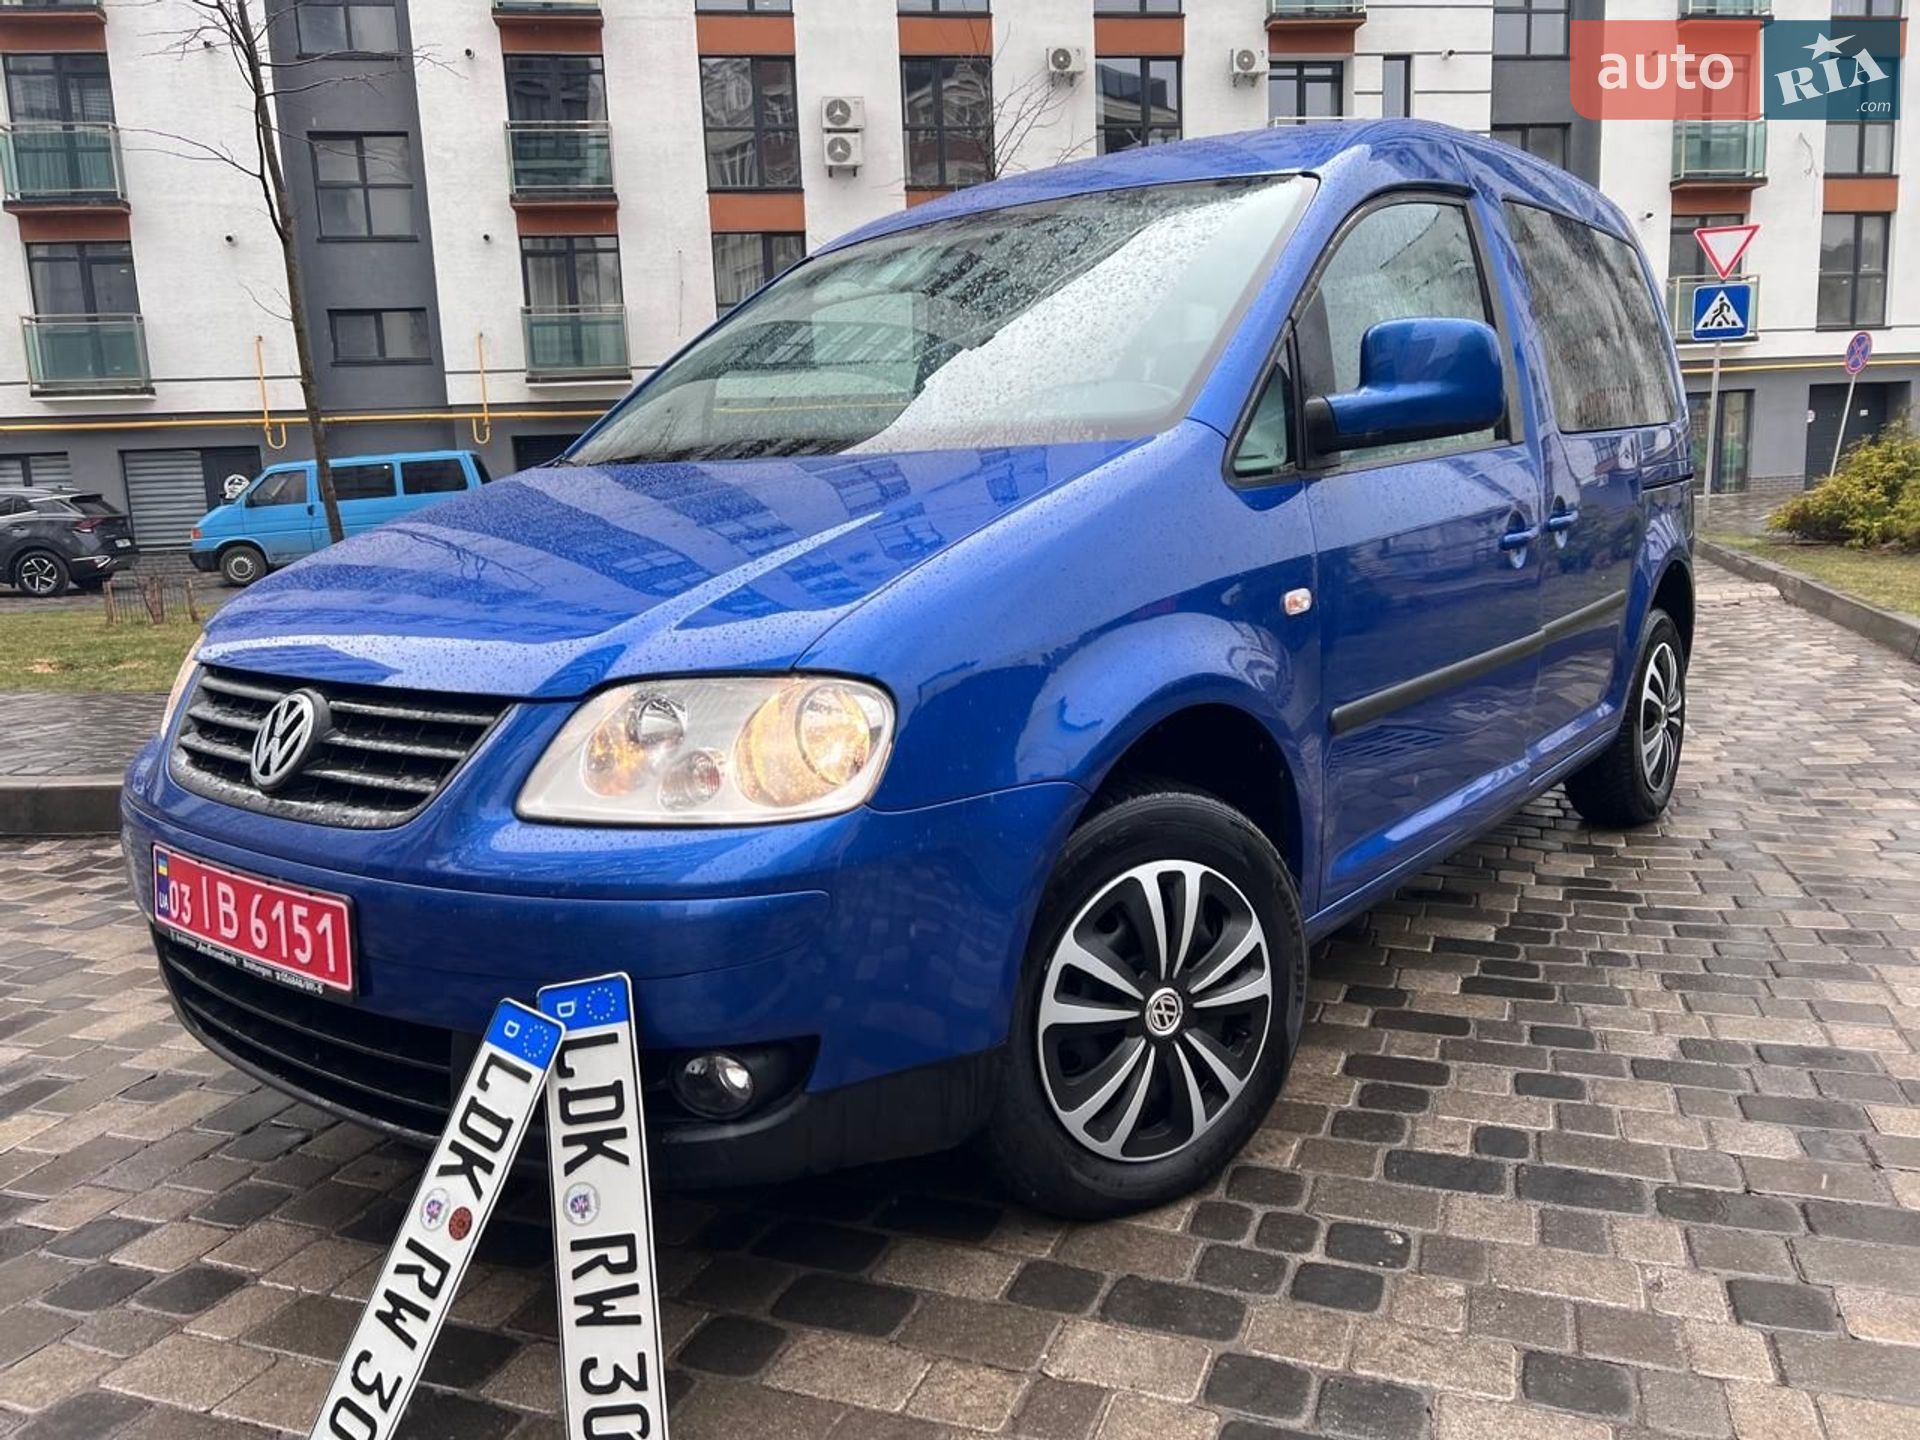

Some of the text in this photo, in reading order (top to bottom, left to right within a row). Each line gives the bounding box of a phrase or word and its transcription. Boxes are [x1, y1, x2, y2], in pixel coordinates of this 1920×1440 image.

[159, 890, 169, 910] UA
[169, 880, 192, 925] 03
[250, 893, 336, 972] 6151
[503, 1020, 521, 1038] D
[556, 1000, 576, 1018] D
[436, 1052, 533, 1201] LDK
[556, 1032, 630, 1177] LDK
[374, 1237, 451, 1350] RW
[570, 1232, 642, 1327] RW
